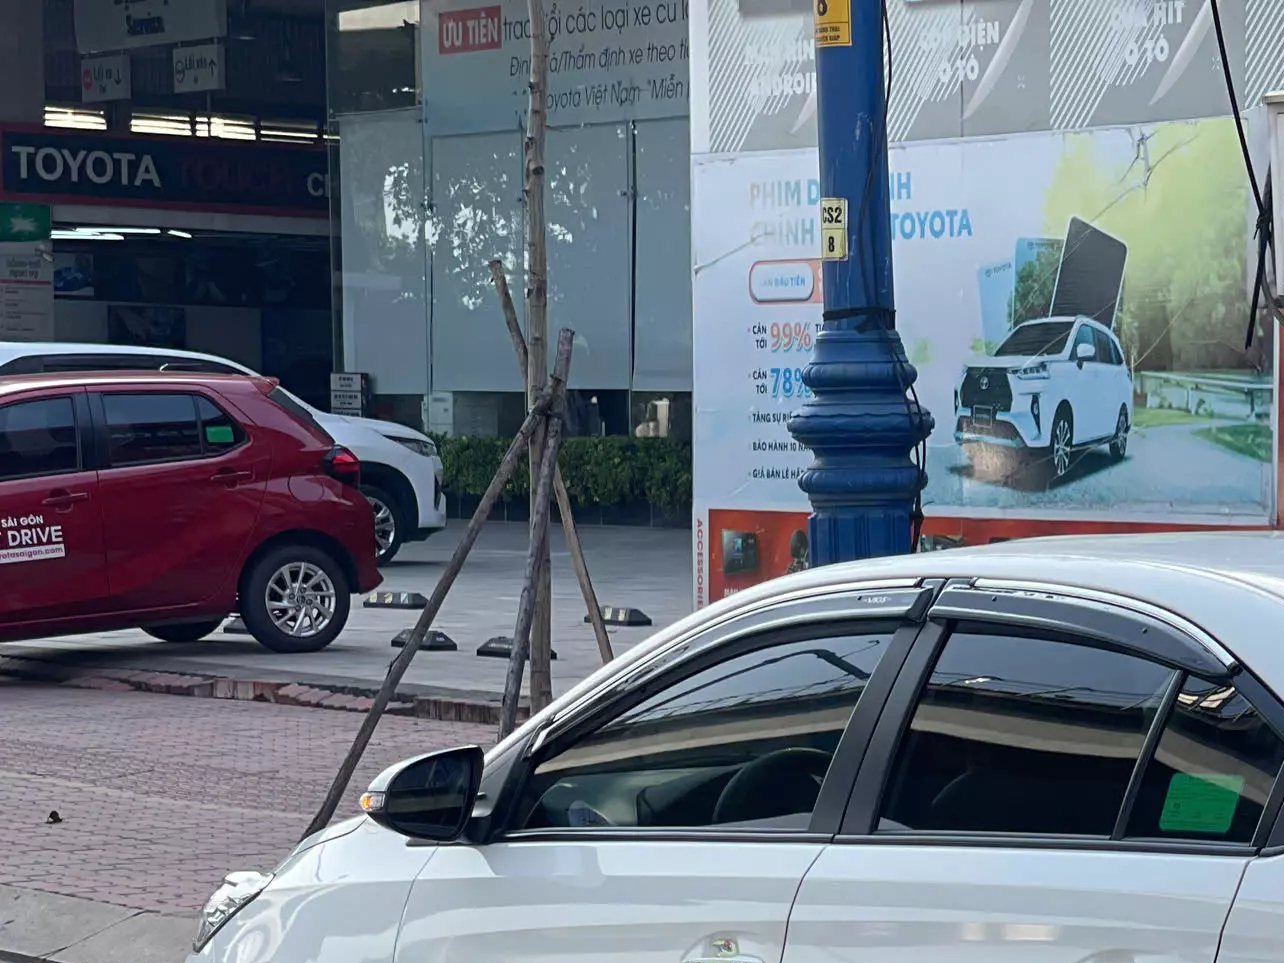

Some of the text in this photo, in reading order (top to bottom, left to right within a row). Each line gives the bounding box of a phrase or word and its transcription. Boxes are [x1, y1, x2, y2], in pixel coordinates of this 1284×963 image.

[467, 11, 498, 45] TIÊN
[565, 6, 596, 34] các
[601, 4, 630, 34] loại
[634, 5, 651, 26] xe
[599, 46, 626, 71] định
[629, 47, 644, 65] xe
[647, 41, 676, 62] theo
[585, 83, 609, 109] Việt
[12, 146, 161, 188] TOYOTA
[750, 180, 802, 208] PHIM
[822, 207, 842, 224] CS2
[829, 237, 835, 252] 8
[770, 321, 812, 352] 99%
[790, 442, 797, 452] 10
[766, 466, 780, 479] BÁN
[1, 516, 18, 528] SÀI
[7, 525, 63, 547] DRIVE
